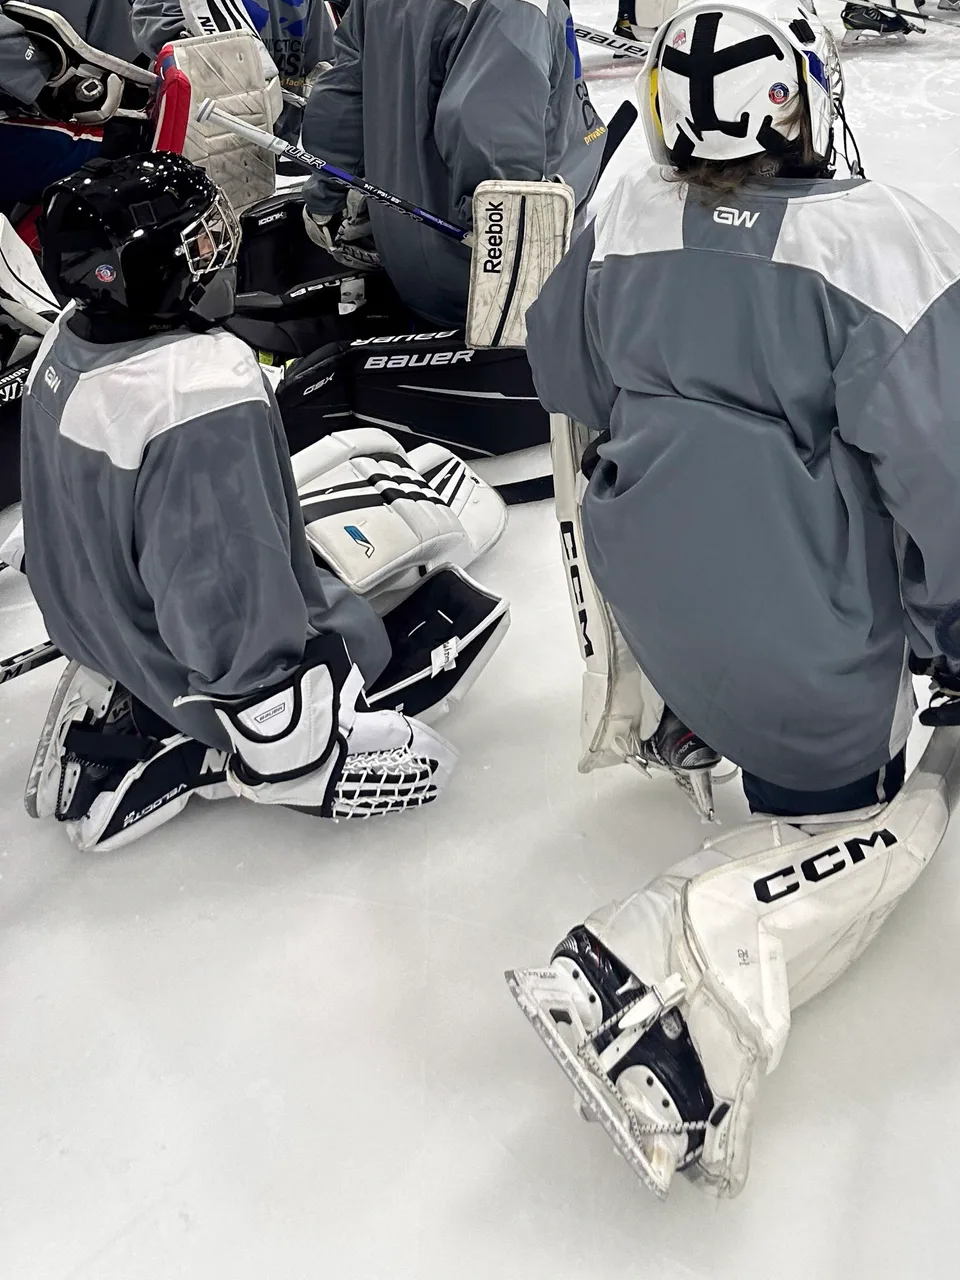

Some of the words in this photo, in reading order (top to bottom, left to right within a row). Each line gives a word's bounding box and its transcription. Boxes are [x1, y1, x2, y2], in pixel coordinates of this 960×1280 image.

[584, 126, 607, 146] private
[483, 201, 504, 274] Reebok
[713, 206, 760, 228] GW
[363, 349, 475, 370] BAUER
[560, 520, 595, 658] CCM
[753, 828, 898, 904] CCM
